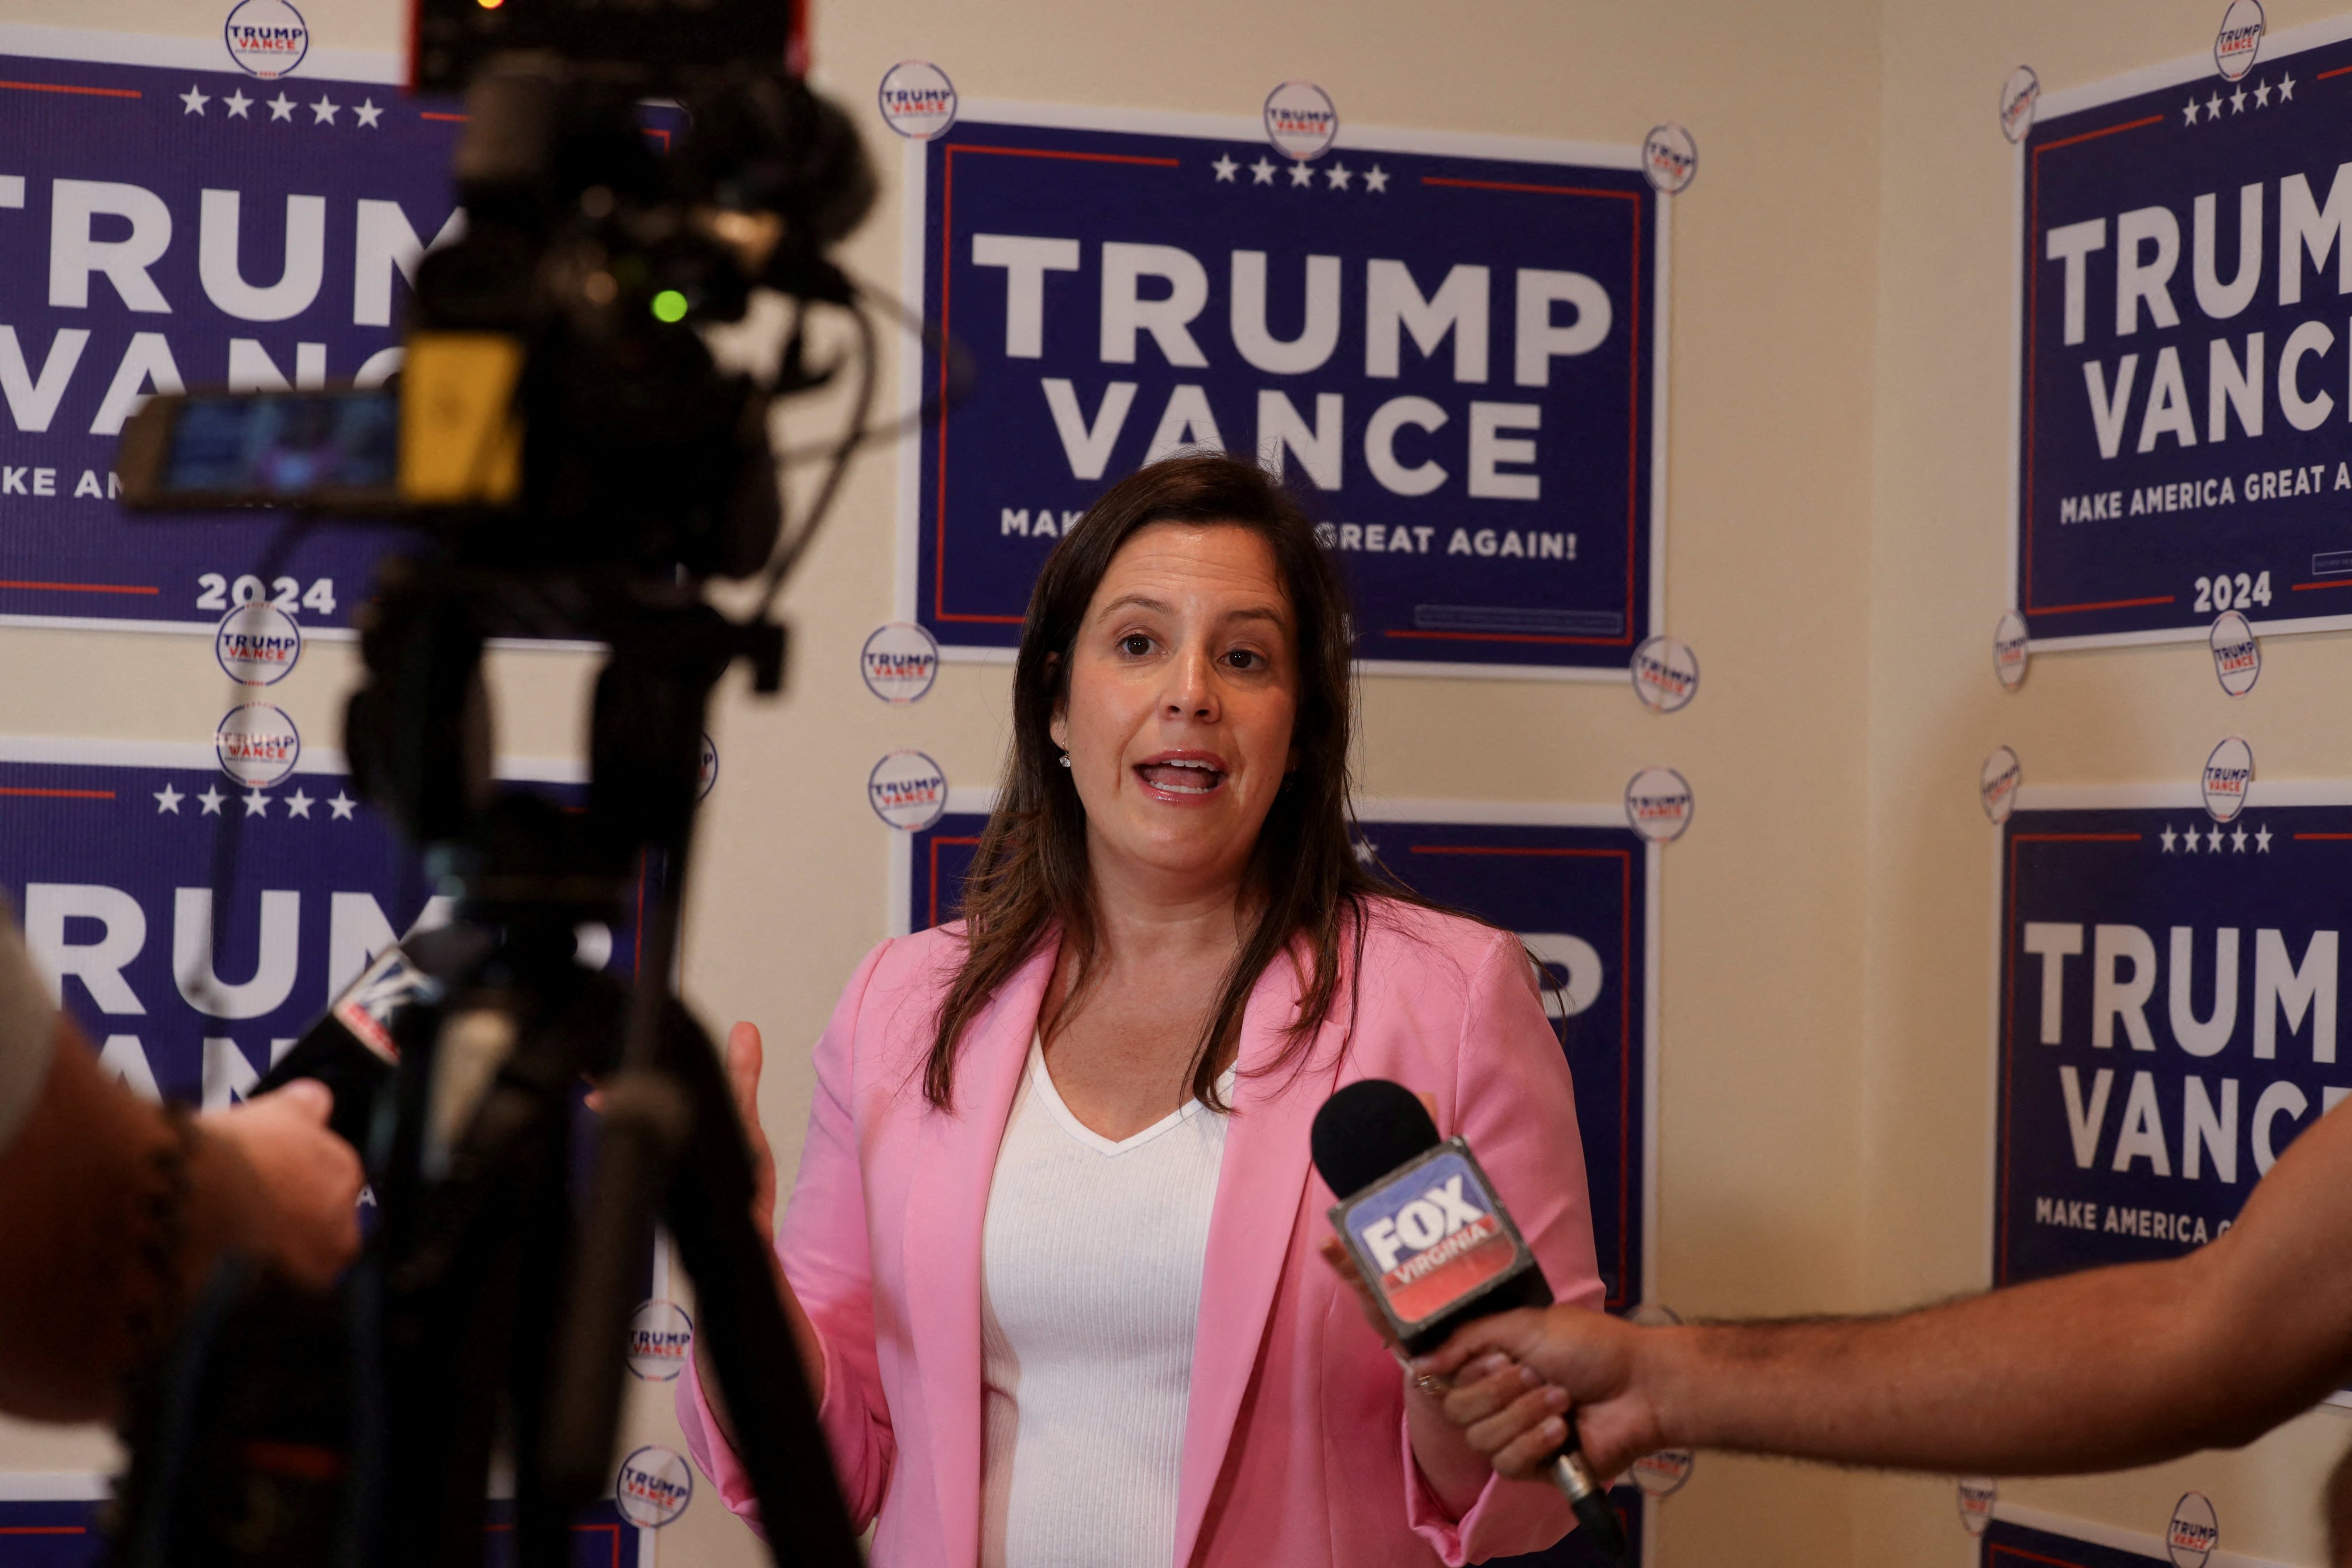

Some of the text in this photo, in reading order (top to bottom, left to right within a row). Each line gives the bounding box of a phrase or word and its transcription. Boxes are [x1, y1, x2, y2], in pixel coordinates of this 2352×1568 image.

[230, 26, 303, 40] TRUMP
[2219, 24, 2261, 44] TRUMP
[239, 37, 296, 50] VANCE
[2220, 36, 2254, 54] VANCE
[884, 90, 951, 102] TRUMP
[891, 100, 946, 113] VANCE
[1269, 107, 1334, 122] TRUMP
[1276, 120, 1327, 133] VANCE
[0, 175, 469, 328] RUM
[972, 233, 1613, 388] TRUMP
[2083, 315, 2352, 460] VANC
[1040, 378, 1542, 501] VANCE
[2060, 491, 2123, 525] MAKE
[2129, 477, 2237, 517] AMERICA
[2244, 465, 2325, 502] GREAT
[1001, 507, 1084, 538] MAK
[1448, 528, 1578, 560] AGAIN!
[196, 573, 337, 616] 2024
[2193, 570, 2272, 613] 2024
[223, 634, 295, 649] TRUMP
[2215, 640, 2254, 662] TRUMP
[229, 647, 285, 660] VANCE
[867, 653, 934, 666] TRUMP
[2223, 655, 2254, 671] VANCE
[872, 665, 925, 677] VANCE
[2207, 767, 2249, 781] TRUMP
[875, 777, 941, 796] TRUMP
[2208, 779, 2241, 793] VANCE
[882, 789, 935, 805] VANCE
[2059, 1065, 2352, 1184] VANC
[1362, 1174, 1486, 1273] FOX
[2036, 1197, 2098, 1231] MAKE
[2103, 1206, 2209, 1245] AMERICA
[1393, 1222, 1488, 1285] VIRGINIA
[629, 1330, 690, 1345] TRUMP
[633, 1343, 683, 1355] VANCE
[625, 1467, 688, 1499] TRUMP
[628, 1481, 675, 1508] VANCE
[2172, 1519, 2216, 1540] TRUMP
